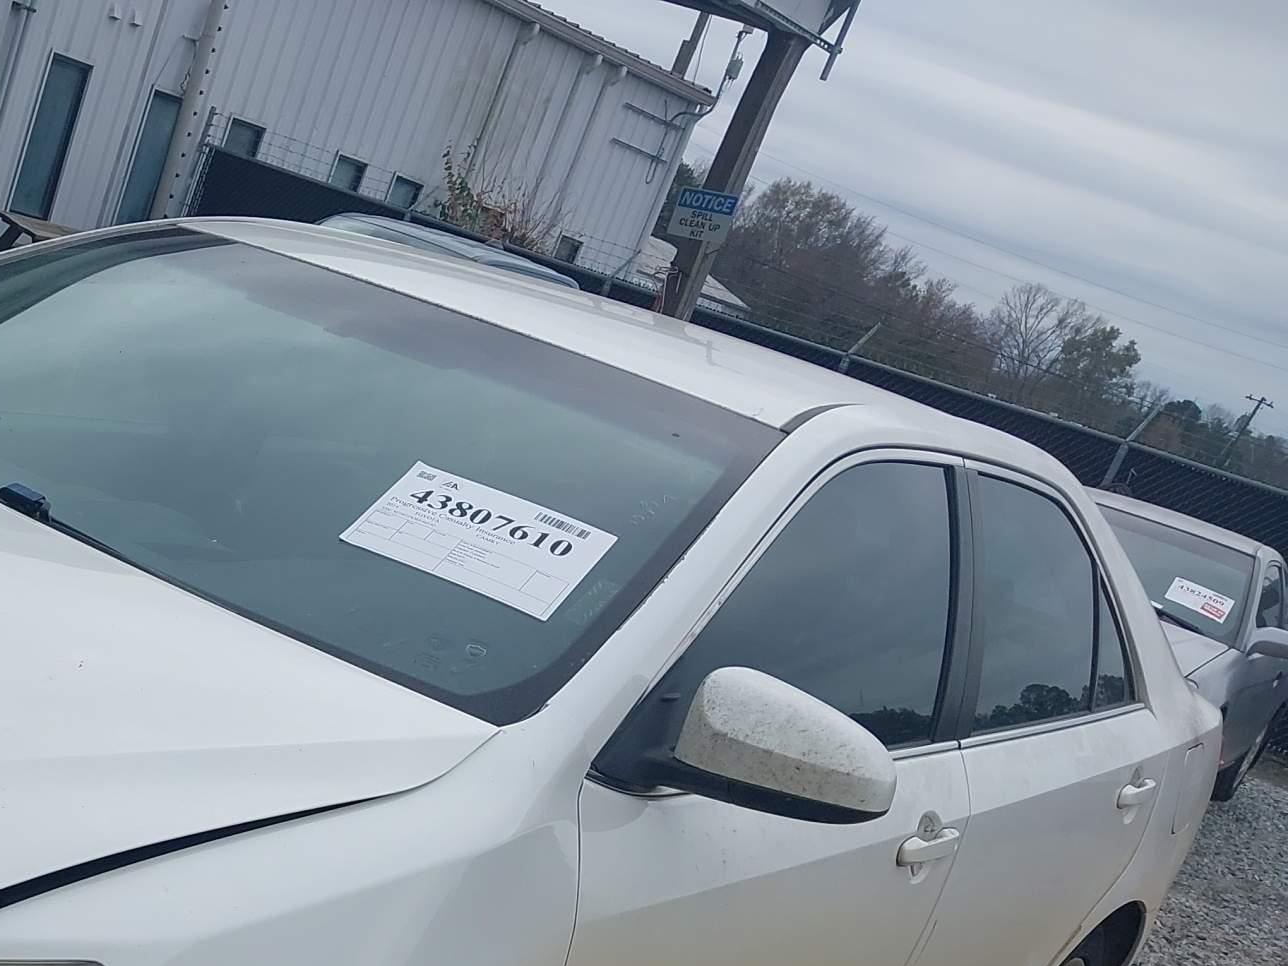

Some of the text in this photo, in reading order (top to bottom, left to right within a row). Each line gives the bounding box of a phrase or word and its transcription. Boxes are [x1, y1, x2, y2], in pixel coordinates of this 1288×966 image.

[680, 191, 735, 212] NOTICE
[679, 217, 721, 232] CLEAN UP
[691, 210, 713, 221] SPILL
[689, 230, 704, 238] KIT
[390, 496, 438, 516] Progressive
[439, 513, 473, 530] Casualty
[475, 526, 516, 545] Insurance
[410, 490, 573, 556] 43807610
